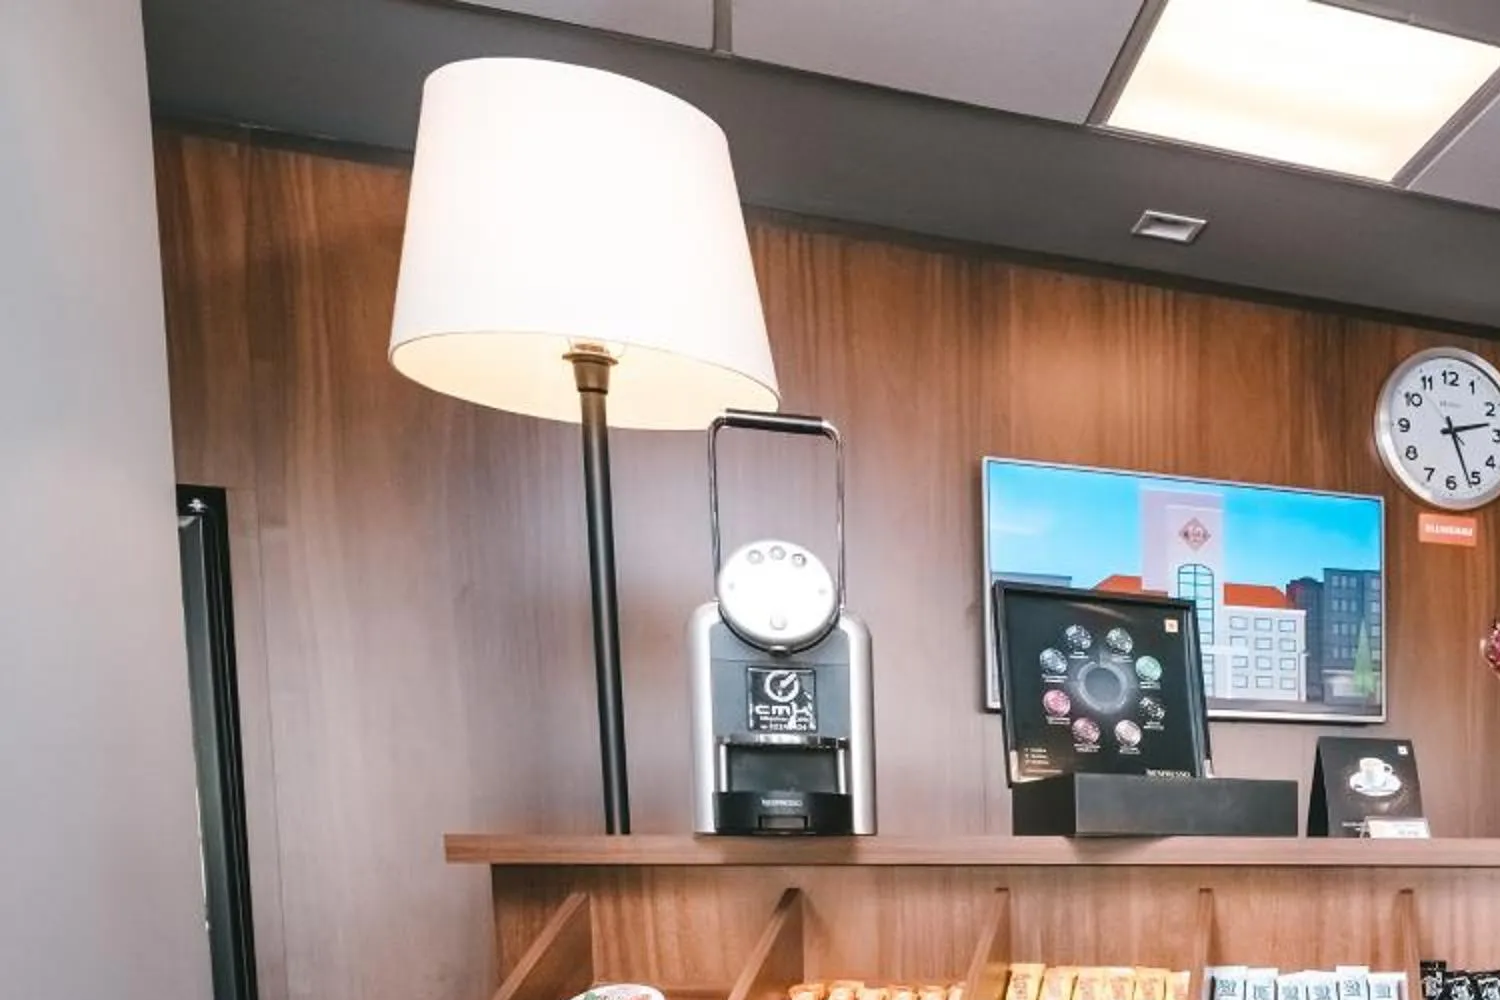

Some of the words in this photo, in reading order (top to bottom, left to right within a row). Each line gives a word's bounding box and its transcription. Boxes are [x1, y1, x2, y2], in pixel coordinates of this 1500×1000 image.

[1421, 375, 1433, 391] 11
[1441, 370, 1459, 387] 12
[1468, 380, 1475, 395] 1
[1404, 392, 1422, 407] 10
[1484, 403, 1495, 417] 2
[1398, 418, 1410, 432] 9
[1405, 446, 1418, 460] 8
[1485, 455, 1496, 469] 4
[1424, 467, 1435, 482] 7
[1471, 471, 1481, 485] 5
[1446, 476, 1456, 490] 6
